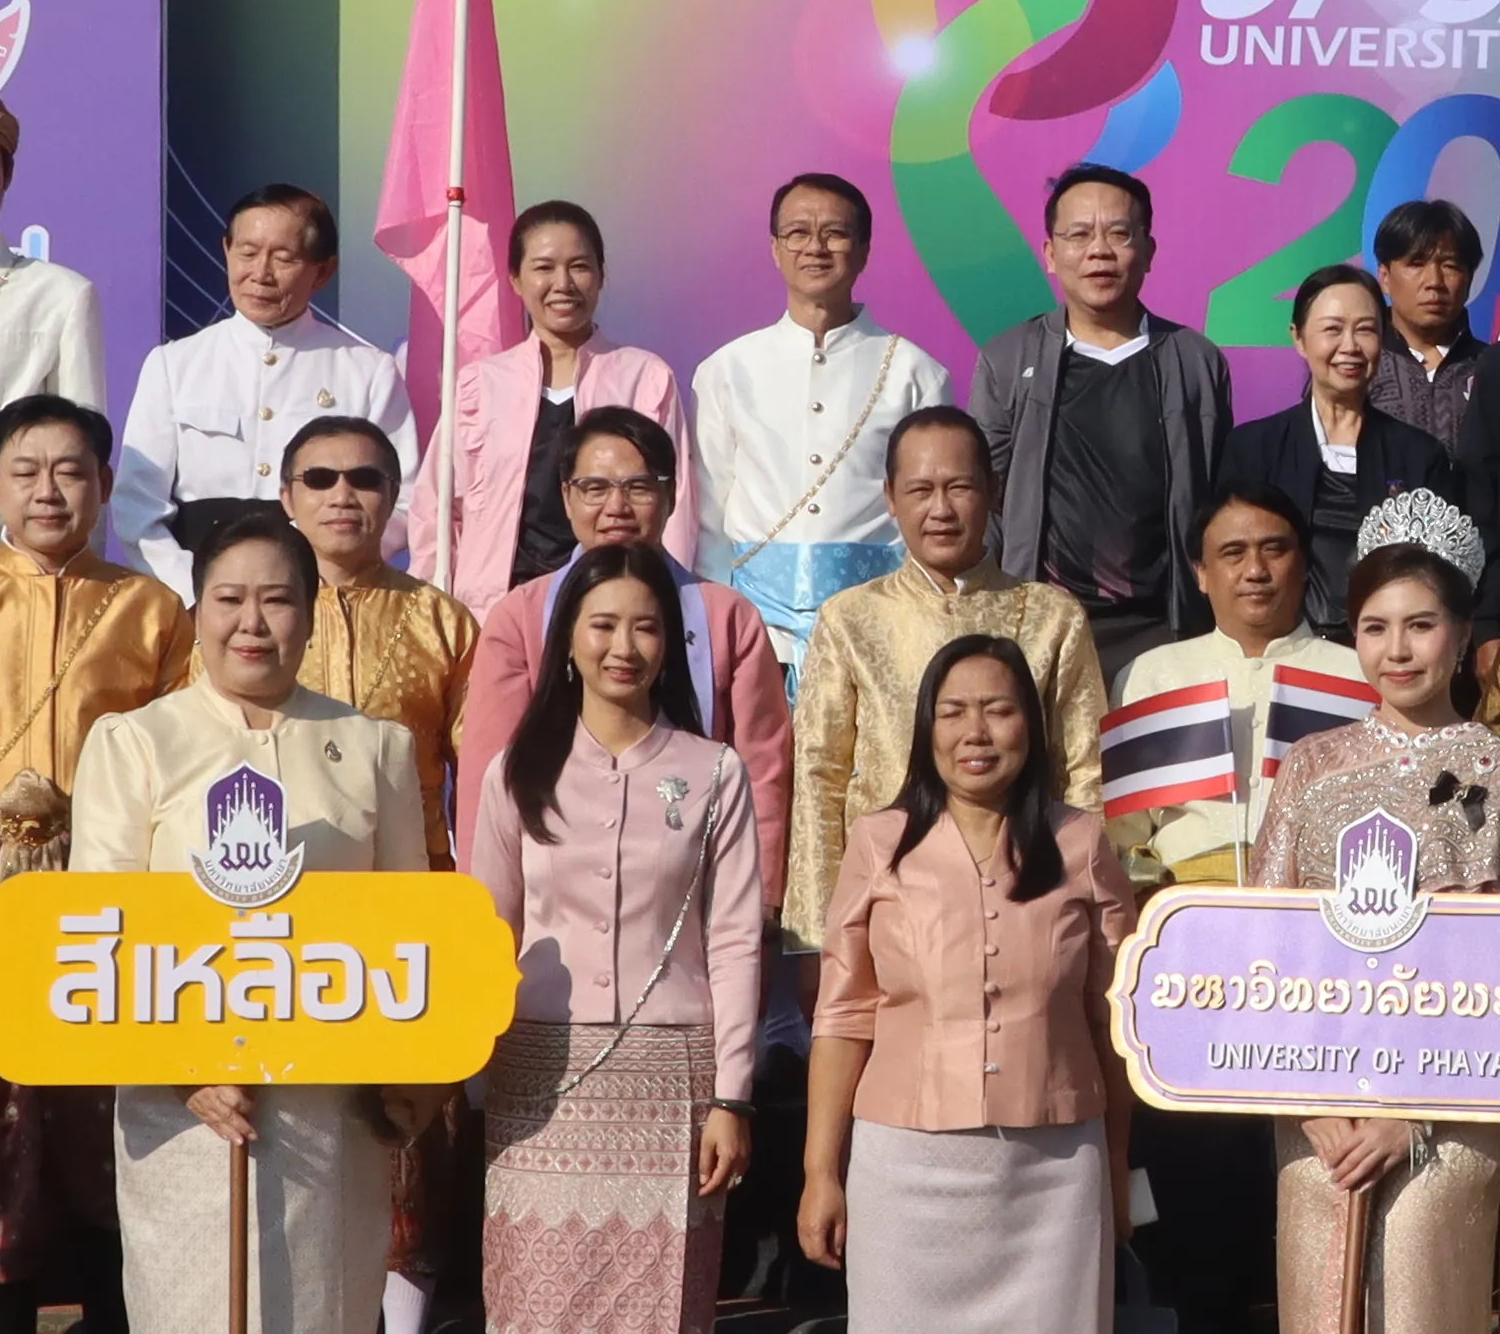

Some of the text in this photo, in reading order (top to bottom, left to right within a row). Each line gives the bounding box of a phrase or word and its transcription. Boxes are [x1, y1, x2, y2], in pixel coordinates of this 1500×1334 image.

[49, 907, 428, 1023] สีเหลือง
[1208, 1041, 1359, 1072] UNIVERSITY
